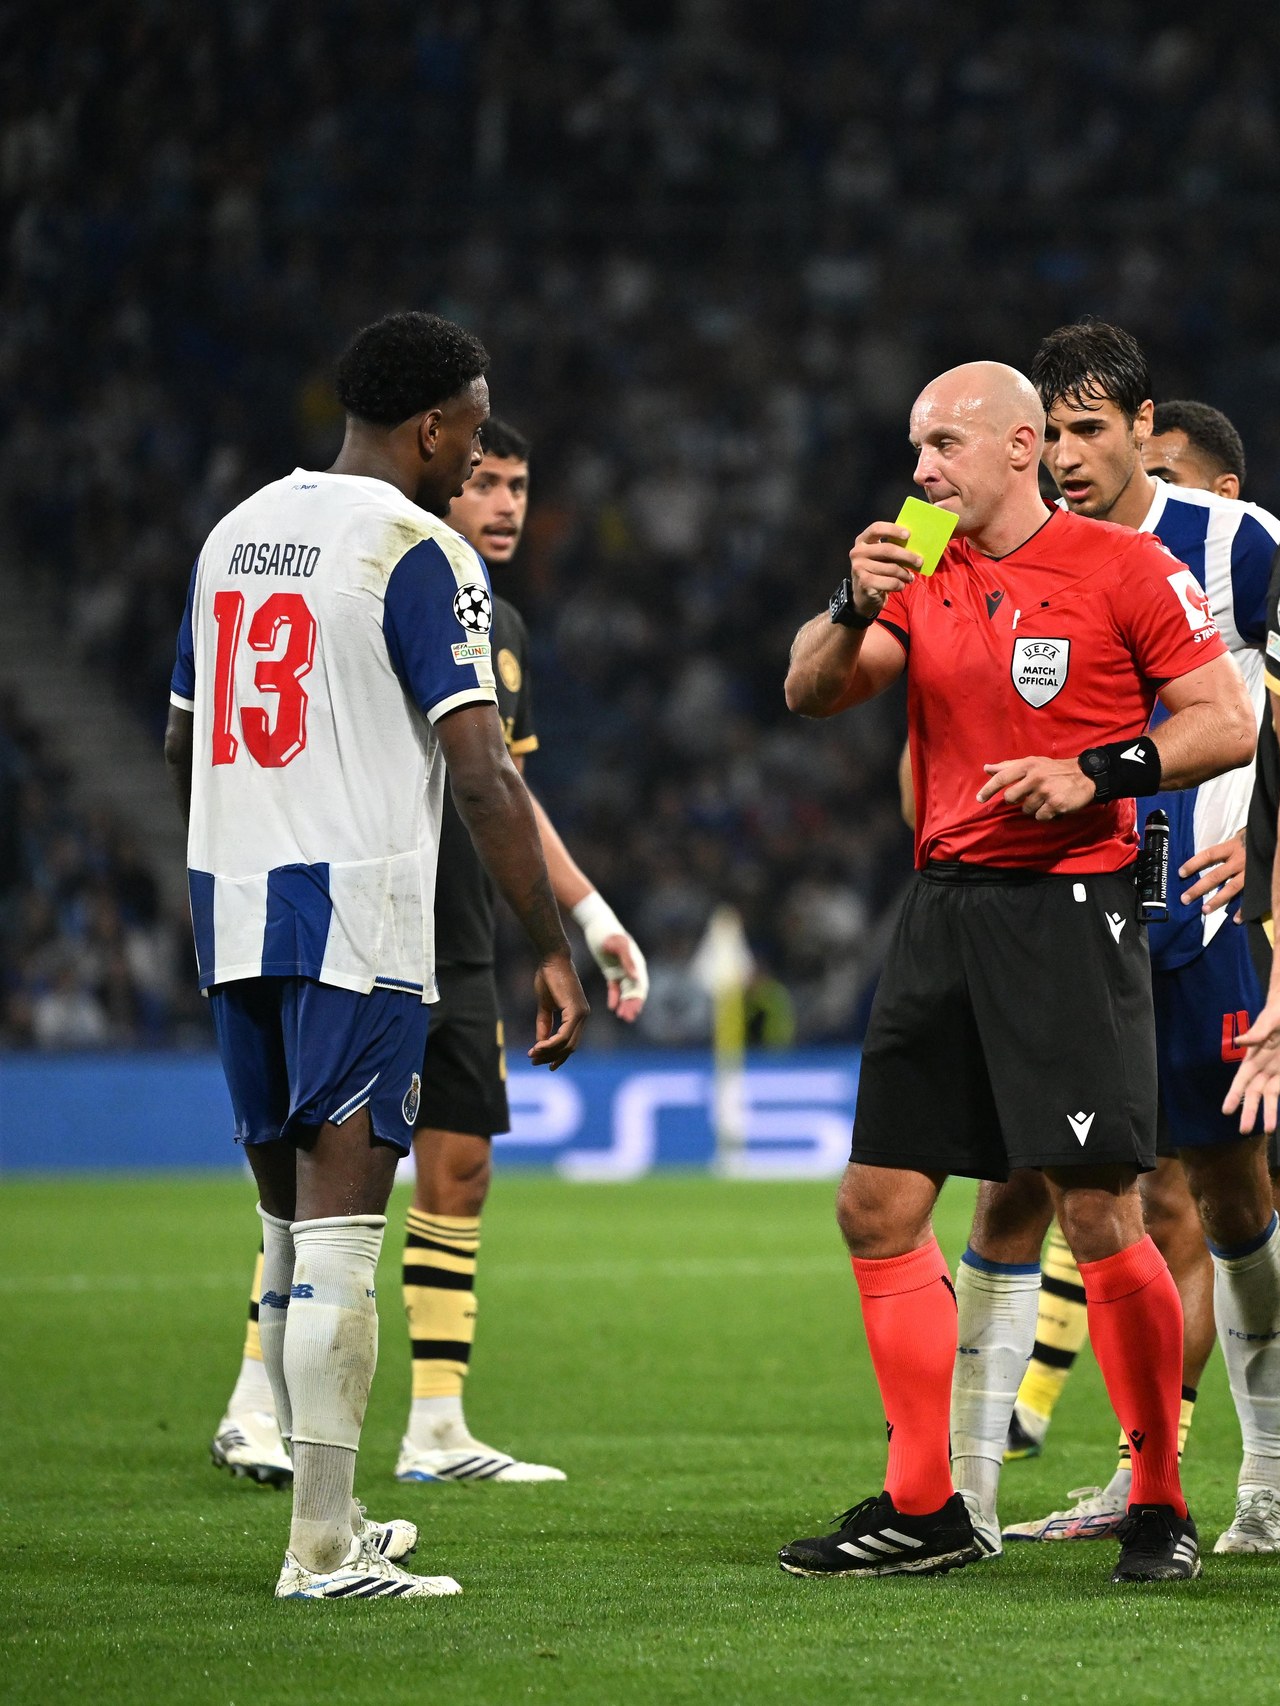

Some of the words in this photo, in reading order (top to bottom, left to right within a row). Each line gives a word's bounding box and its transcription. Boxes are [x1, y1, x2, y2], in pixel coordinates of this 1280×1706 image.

[228, 543, 321, 577] ROSARIO
[454, 647, 489, 658] FOUND
[1024, 645, 1056, 659] UEFA
[1023, 666, 1056, 676] MATCH
[212, 590, 317, 768] 13
[1018, 676, 1059, 687] OFFICIAL
[1160, 860, 1169, 899] VANISHING
